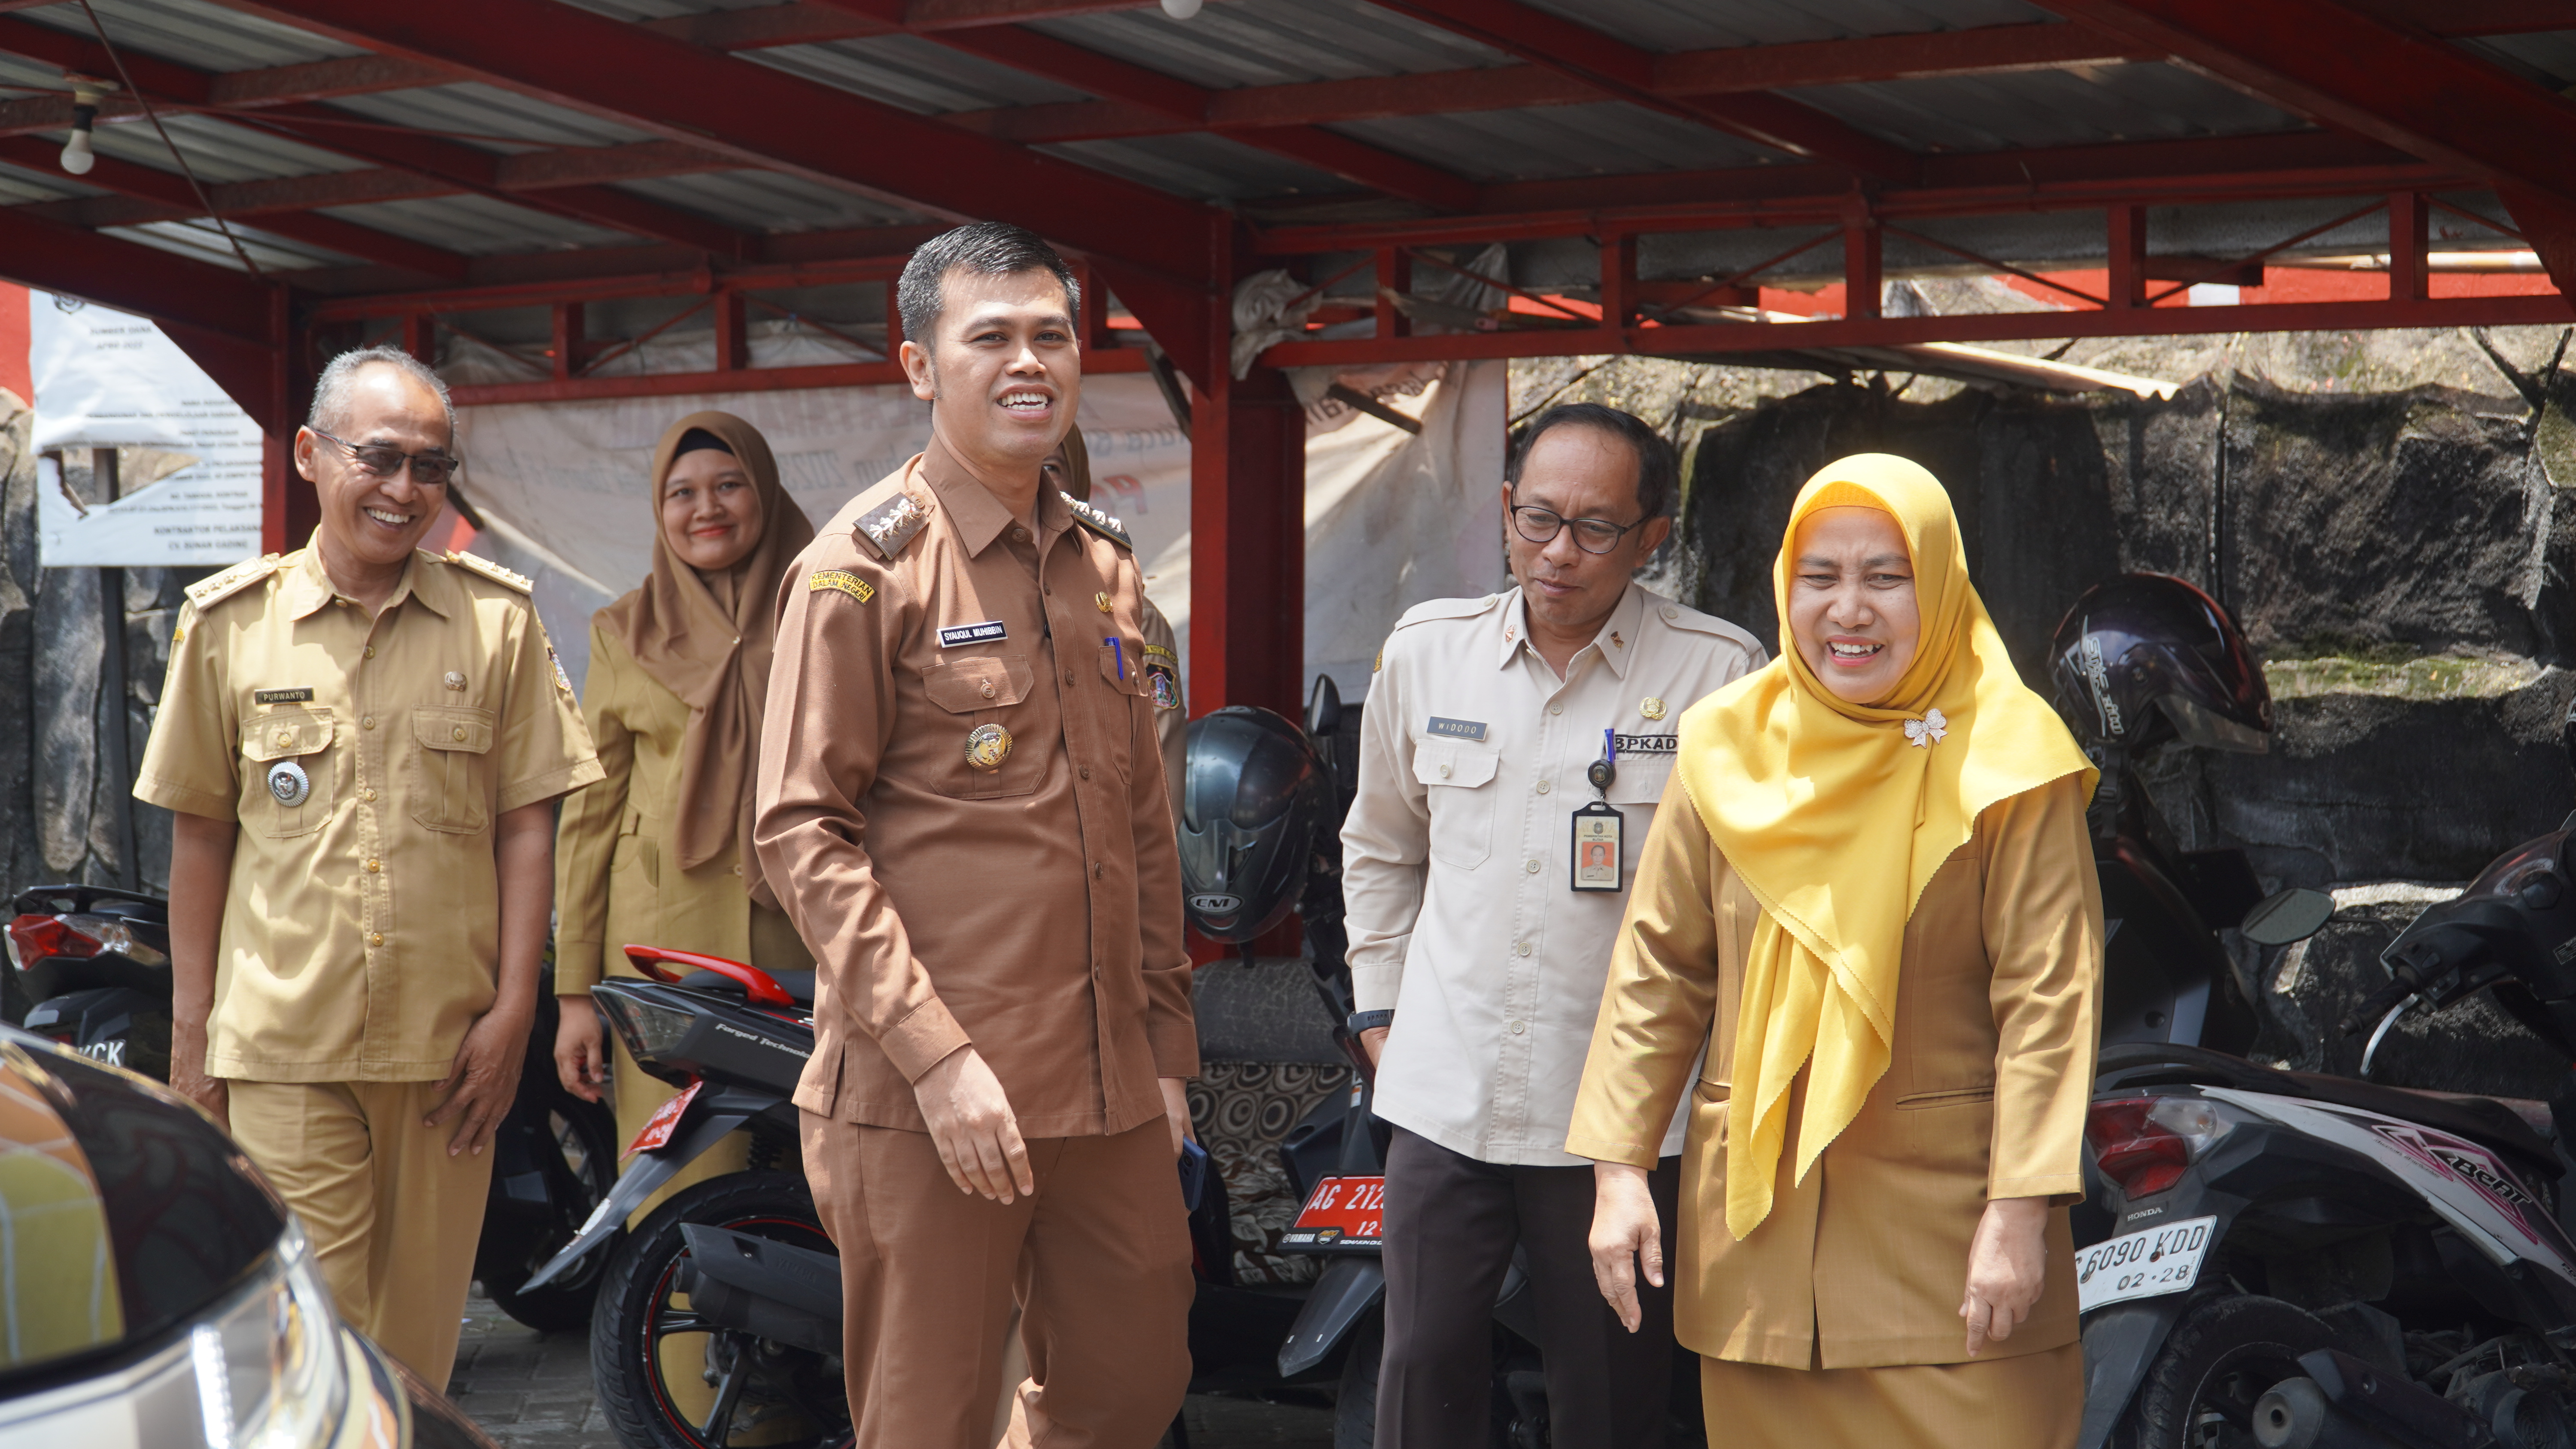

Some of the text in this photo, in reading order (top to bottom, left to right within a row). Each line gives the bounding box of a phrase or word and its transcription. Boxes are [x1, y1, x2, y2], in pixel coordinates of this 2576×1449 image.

[812, 572, 872, 595] KEMENTERIAN
[813, 580, 866, 600] DALAM NEGERI
[944, 625, 1003, 641] SYAUQUL MUHIBBIN
[264, 691, 305, 701] PURWANTO
[1439, 723, 1476, 734] WIDODO
[1616, 738, 1677, 749] BPKAD
[715, 1023, 811, 1059] Forged Technolo
[1308, 1184, 1383, 1210] AG 212
[2127, 1207, 2163, 1222] HONDA
[1289, 1234, 1315, 1243] YAMAHA
[2081, 1237, 2146, 1282] 6090
[2151, 1225, 2206, 1258] KDD
